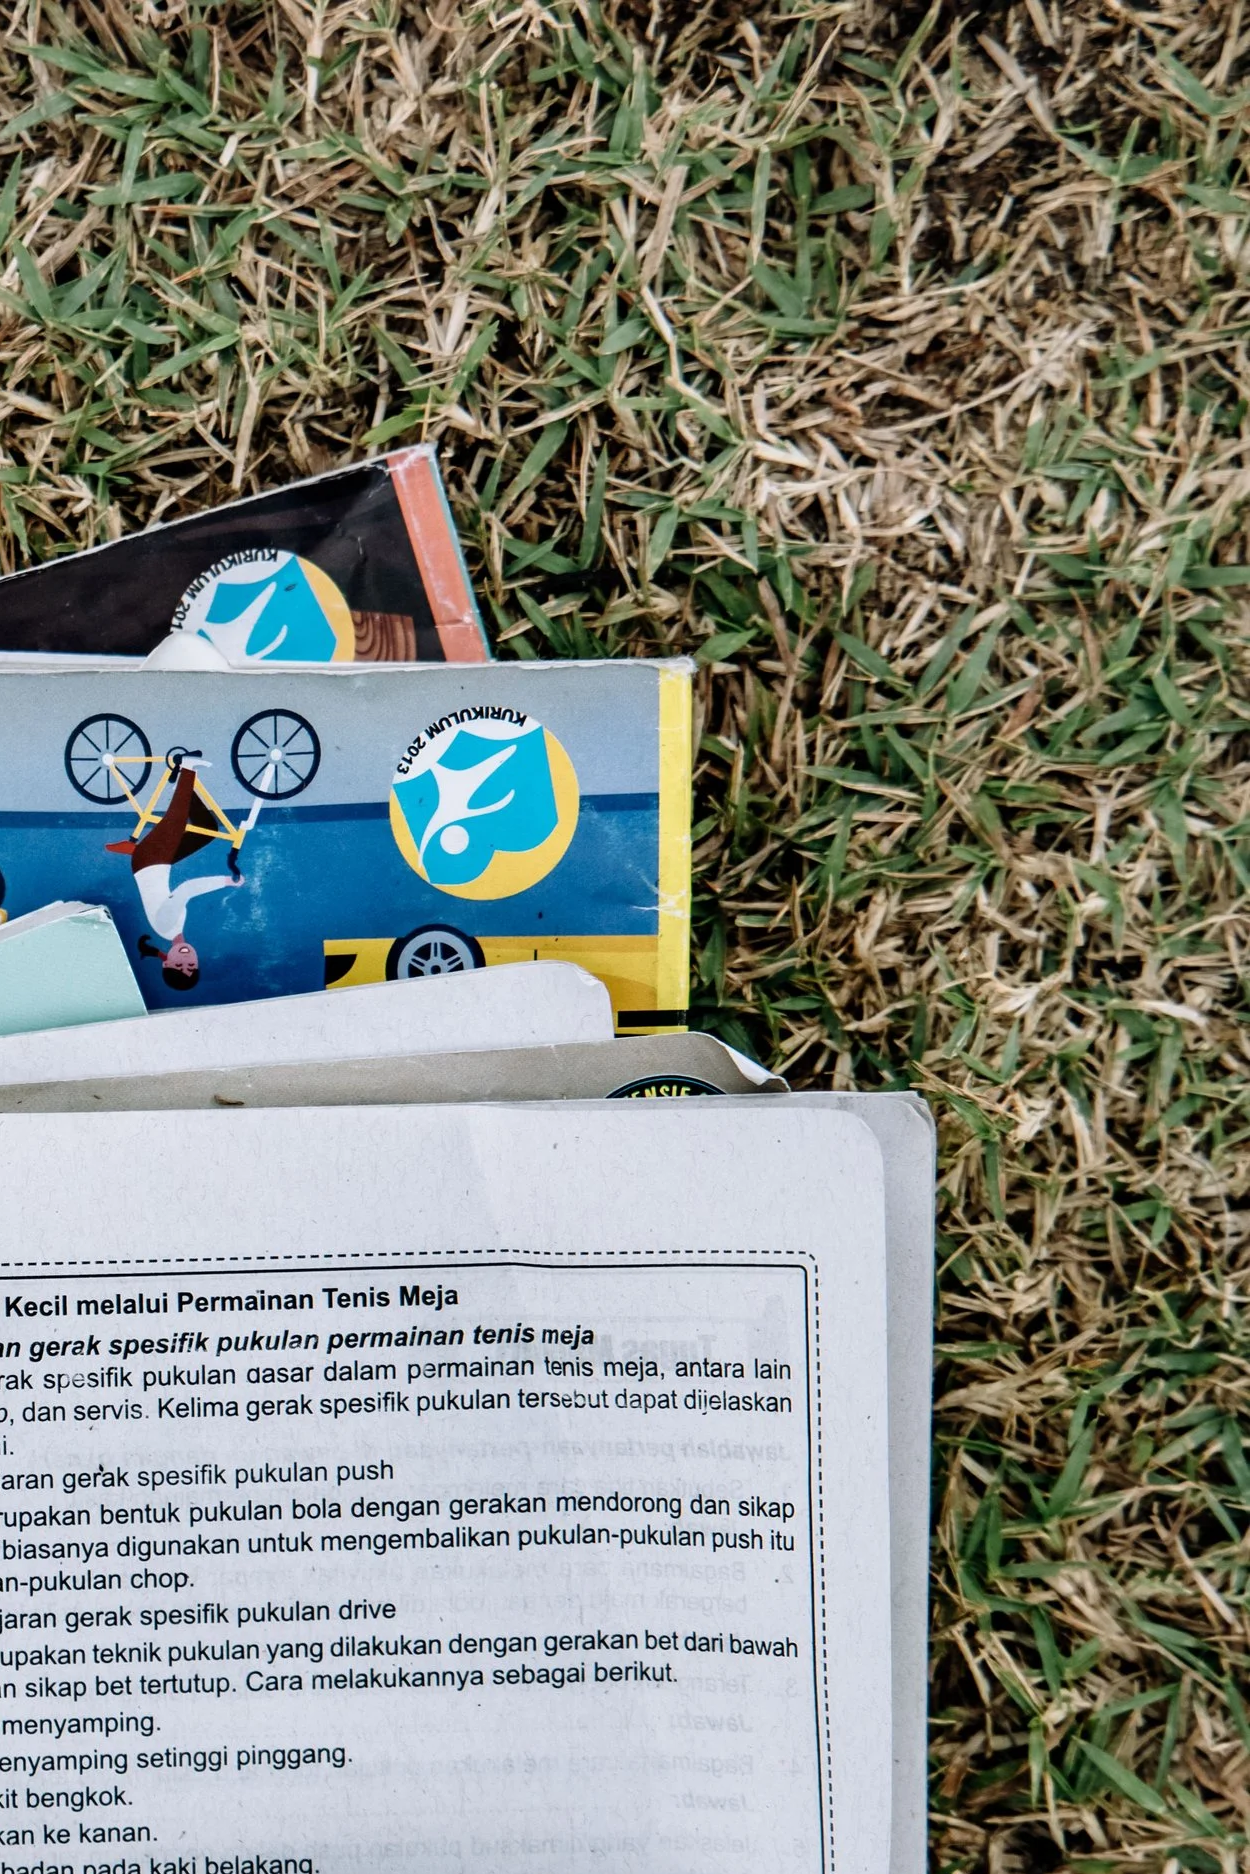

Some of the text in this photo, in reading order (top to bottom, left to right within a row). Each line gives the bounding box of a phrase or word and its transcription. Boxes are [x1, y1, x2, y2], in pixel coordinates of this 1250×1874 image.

[170, 548, 279, 632] KURIKULUM 201
[396, 706, 528, 775] KURIKULUM 2013
[5, 1294, 68, 1318] Kecil
[76, 1292, 168, 1316] melalui
[177, 1289, 314, 1313] Permainan
[321, 1286, 391, 1309] Tenis
[399, 1284, 459, 1312] Meja
[28, 1334, 102, 1363] gerak
[108, 1331, 210, 1361] spesifik
[215, 1329, 320, 1357] pukulan
[326, 1325, 465, 1355] permainan
[473, 1324, 535, 1345] tenis
[541, 1324, 595, 1351] meja
[130, 1567, 195, 1593] chop.
[64, 1605, 133, 1634] gerak
[139, 1602, 230, 1631] spesifik
[237, 1600, 331, 1629] pukulan
[338, 1598, 397, 1621] drive
[1, 1715, 161, 1740] menyamping.
[136, 1747, 228, 1773] setinggi
[236, 1746, 353, 1772] pinggang.
[26, 1784, 133, 1813] bengkok.
[43, 1823, 71, 1845] ke
[78, 1822, 158, 1844] kanan.
